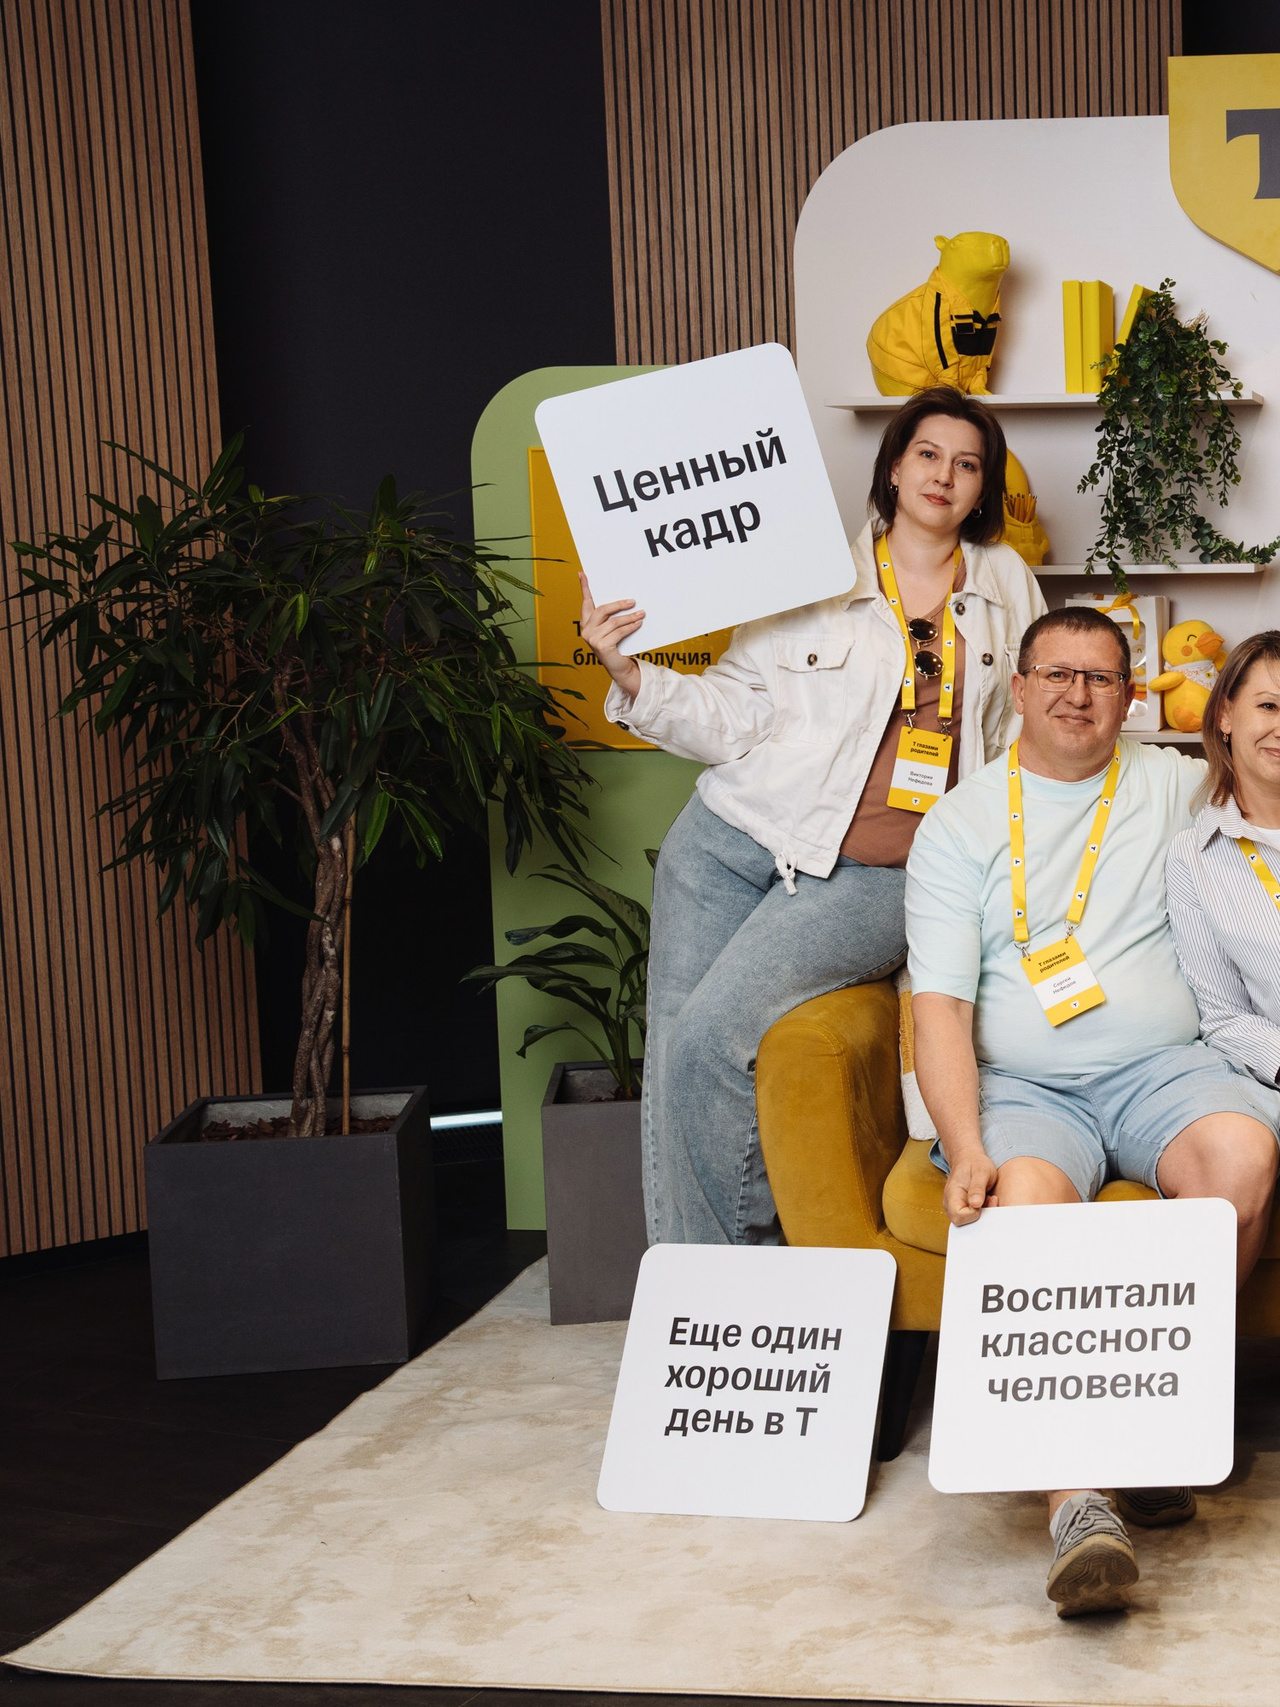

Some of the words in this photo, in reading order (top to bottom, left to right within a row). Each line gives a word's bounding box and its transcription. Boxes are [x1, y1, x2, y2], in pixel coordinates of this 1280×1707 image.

[592, 427, 788, 514] Ценный
[643, 501, 762, 559] кадр
[910, 747, 939, 757] родителей
[916, 742, 939, 751] глазами
[1039, 955, 1070, 974] родителей
[1042, 951, 1067, 966] глазами
[981, 1282, 1195, 1314] Воспитали
[668, 1316, 742, 1352] Еще
[751, 1325, 842, 1355] один
[981, 1326, 1191, 1358] классного
[664, 1362, 831, 1397] хороший
[988, 1372, 1179, 1402] человека
[664, 1408, 754, 1437] день
[763, 1410, 785, 1435] в
[795, 1406, 818, 1437] Т
